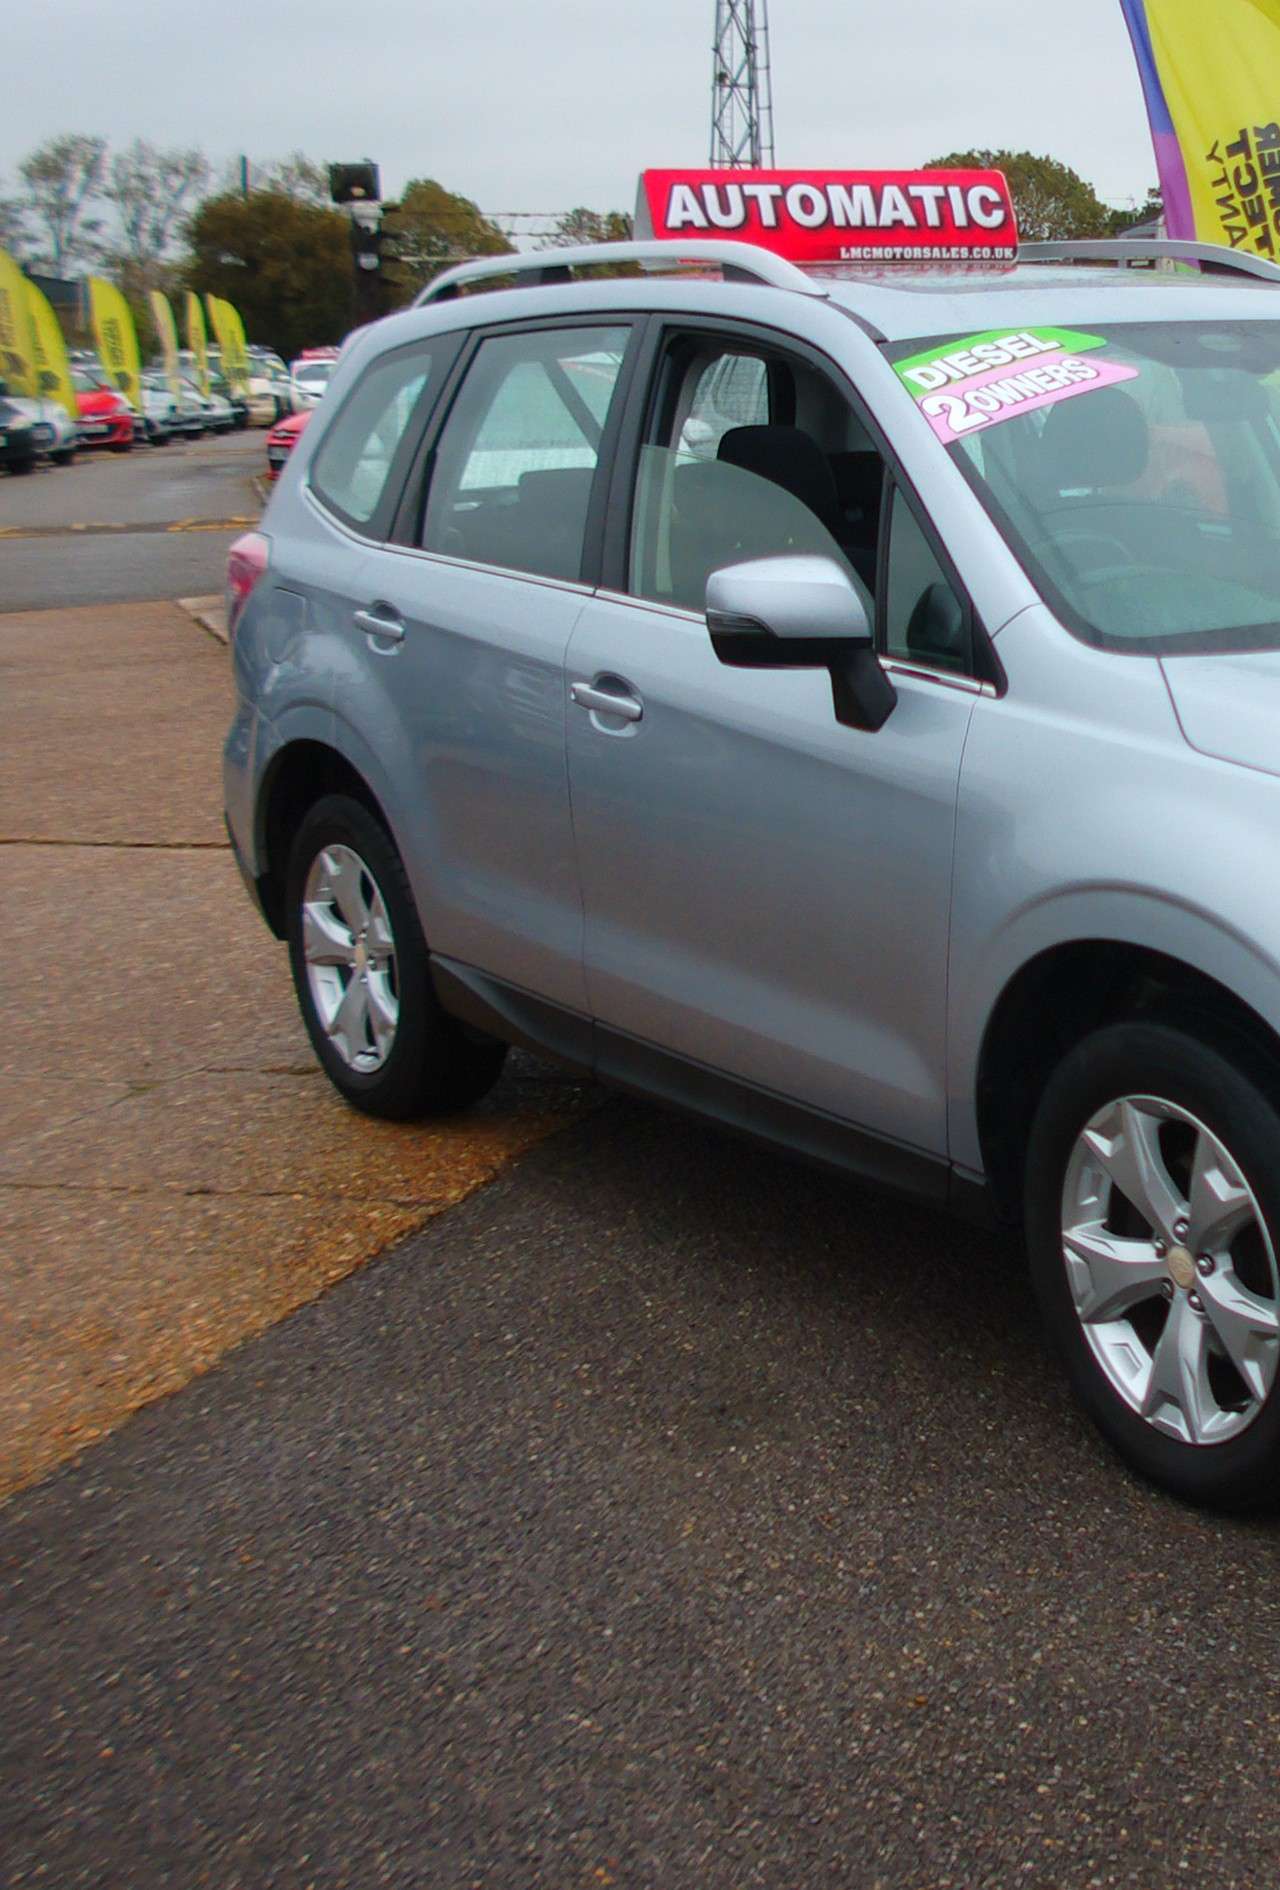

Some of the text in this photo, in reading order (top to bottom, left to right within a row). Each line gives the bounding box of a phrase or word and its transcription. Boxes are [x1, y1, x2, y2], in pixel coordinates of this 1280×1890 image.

[666, 184, 1006, 228] AUTOMATIC
[840, 246, 1014, 260] LMCMOTORSALES.CO.UK
[902, 331, 1063, 391] DIESEL
